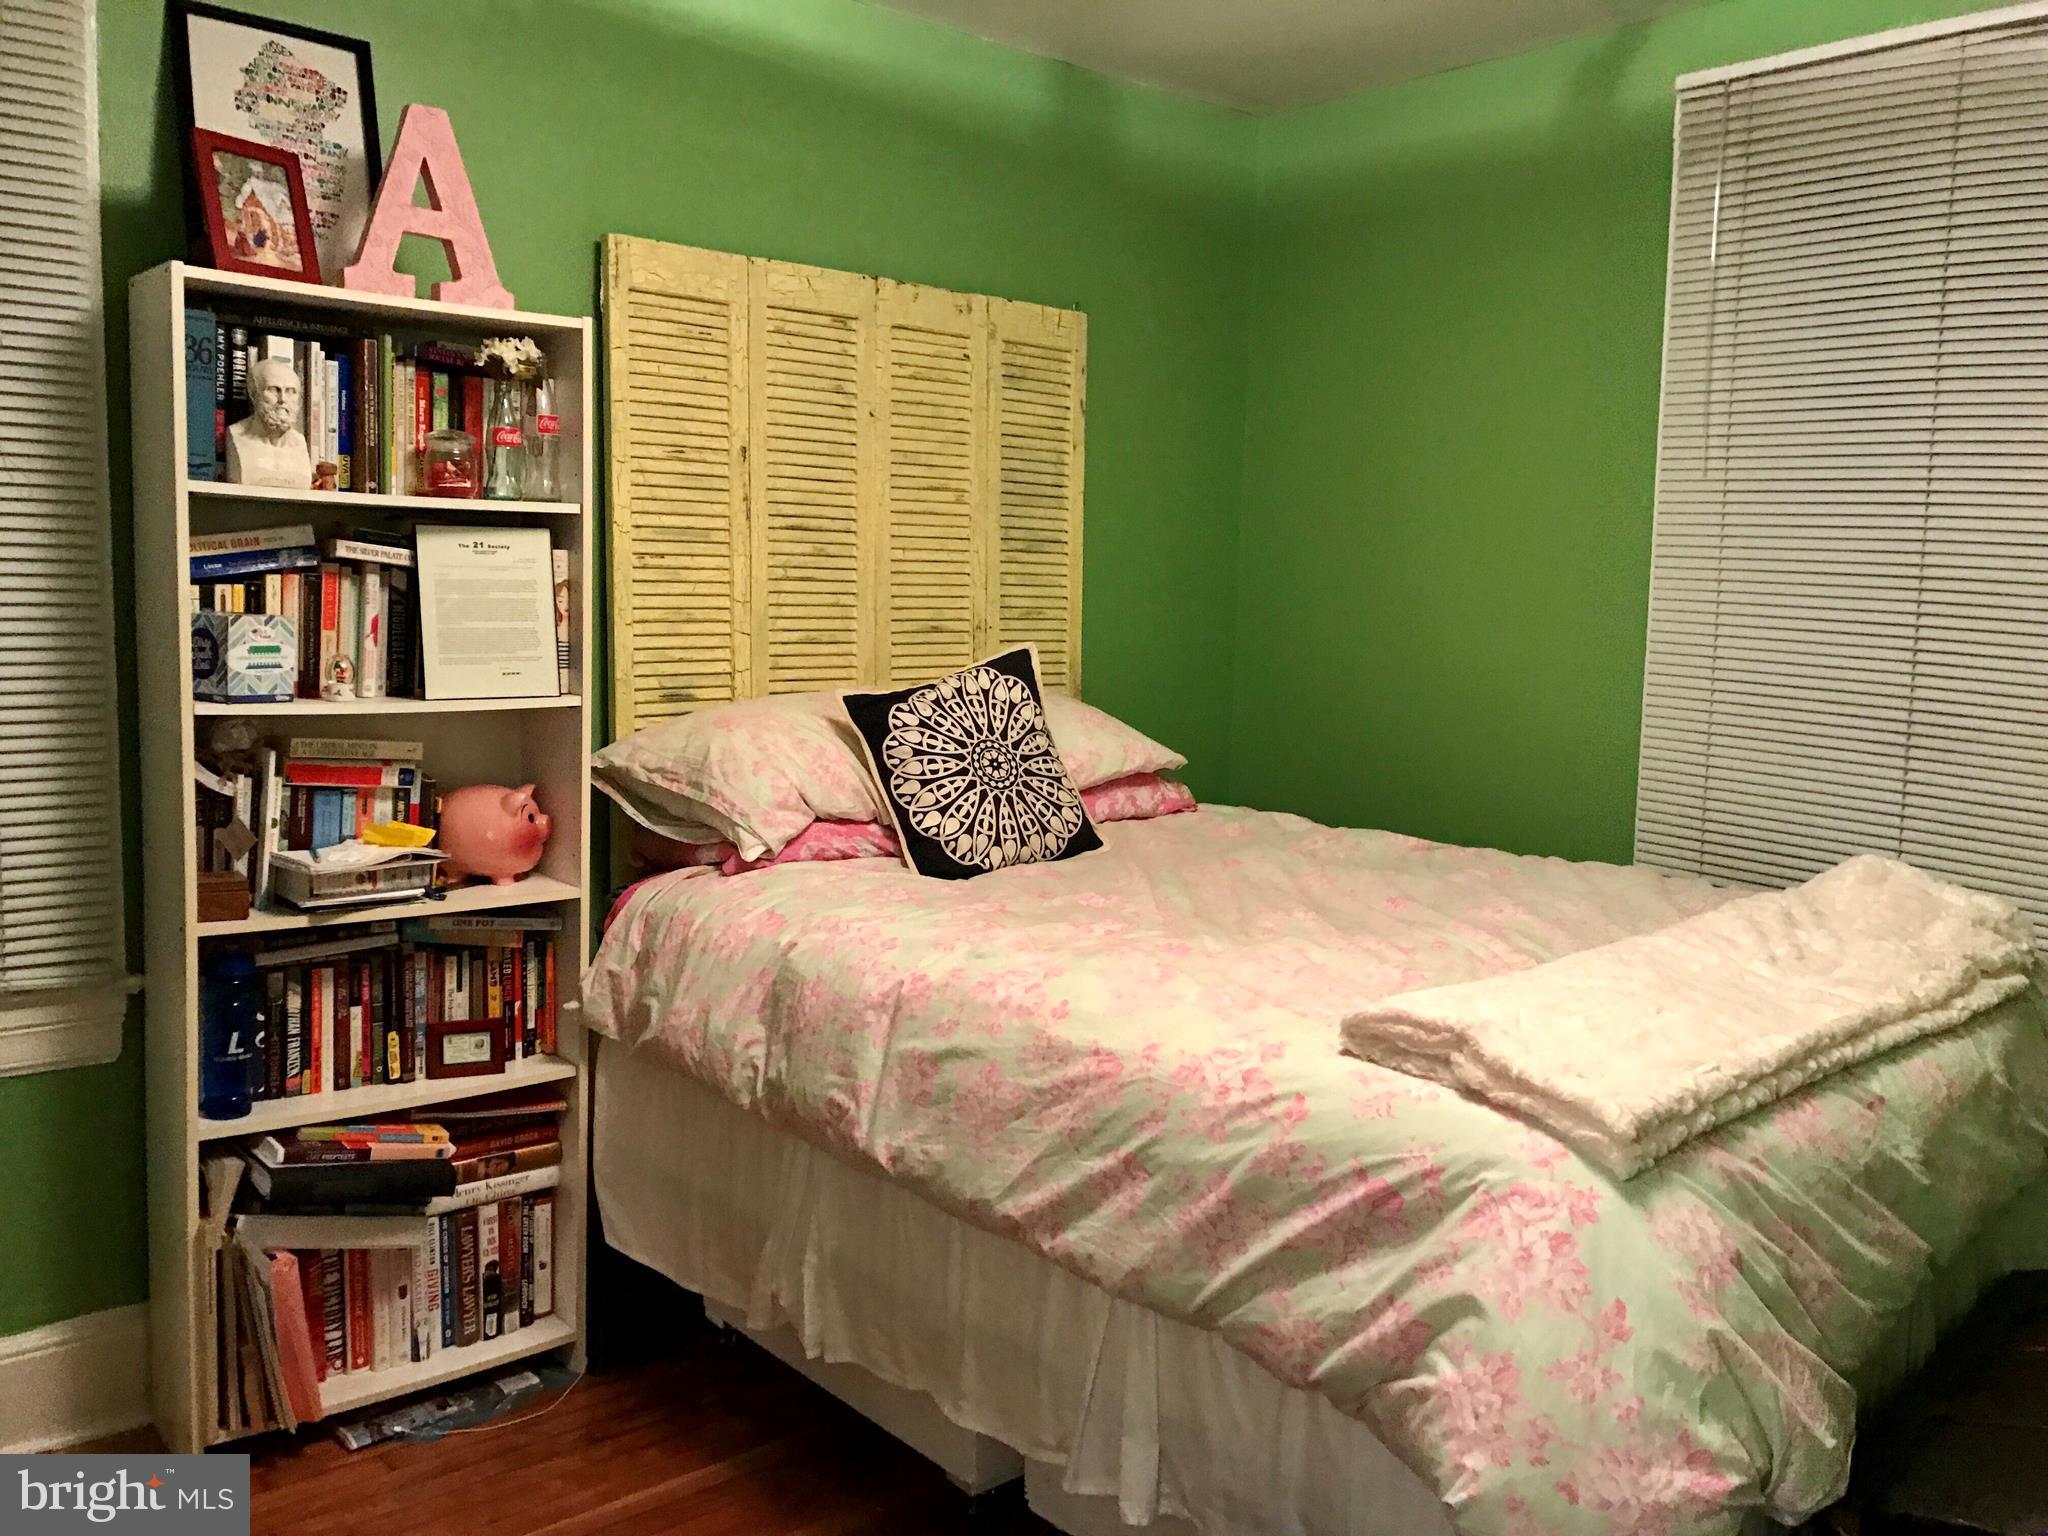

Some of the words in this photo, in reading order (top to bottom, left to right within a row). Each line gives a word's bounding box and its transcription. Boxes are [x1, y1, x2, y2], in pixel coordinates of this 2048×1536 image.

[343, 104, 514, 310] A
[217, 328, 225, 350] AMY
[217, 353, 225, 400] POEHLER
[473, 541, 484, 549] 21
[452, 919, 474, 928] ONE
[475, 920, 497, 928] POT
[485, 1174, 530, 1191] Kissinger
[427, 1269, 439, 1312] GIVING
[461, 1285, 476, 1335] LAWYER
